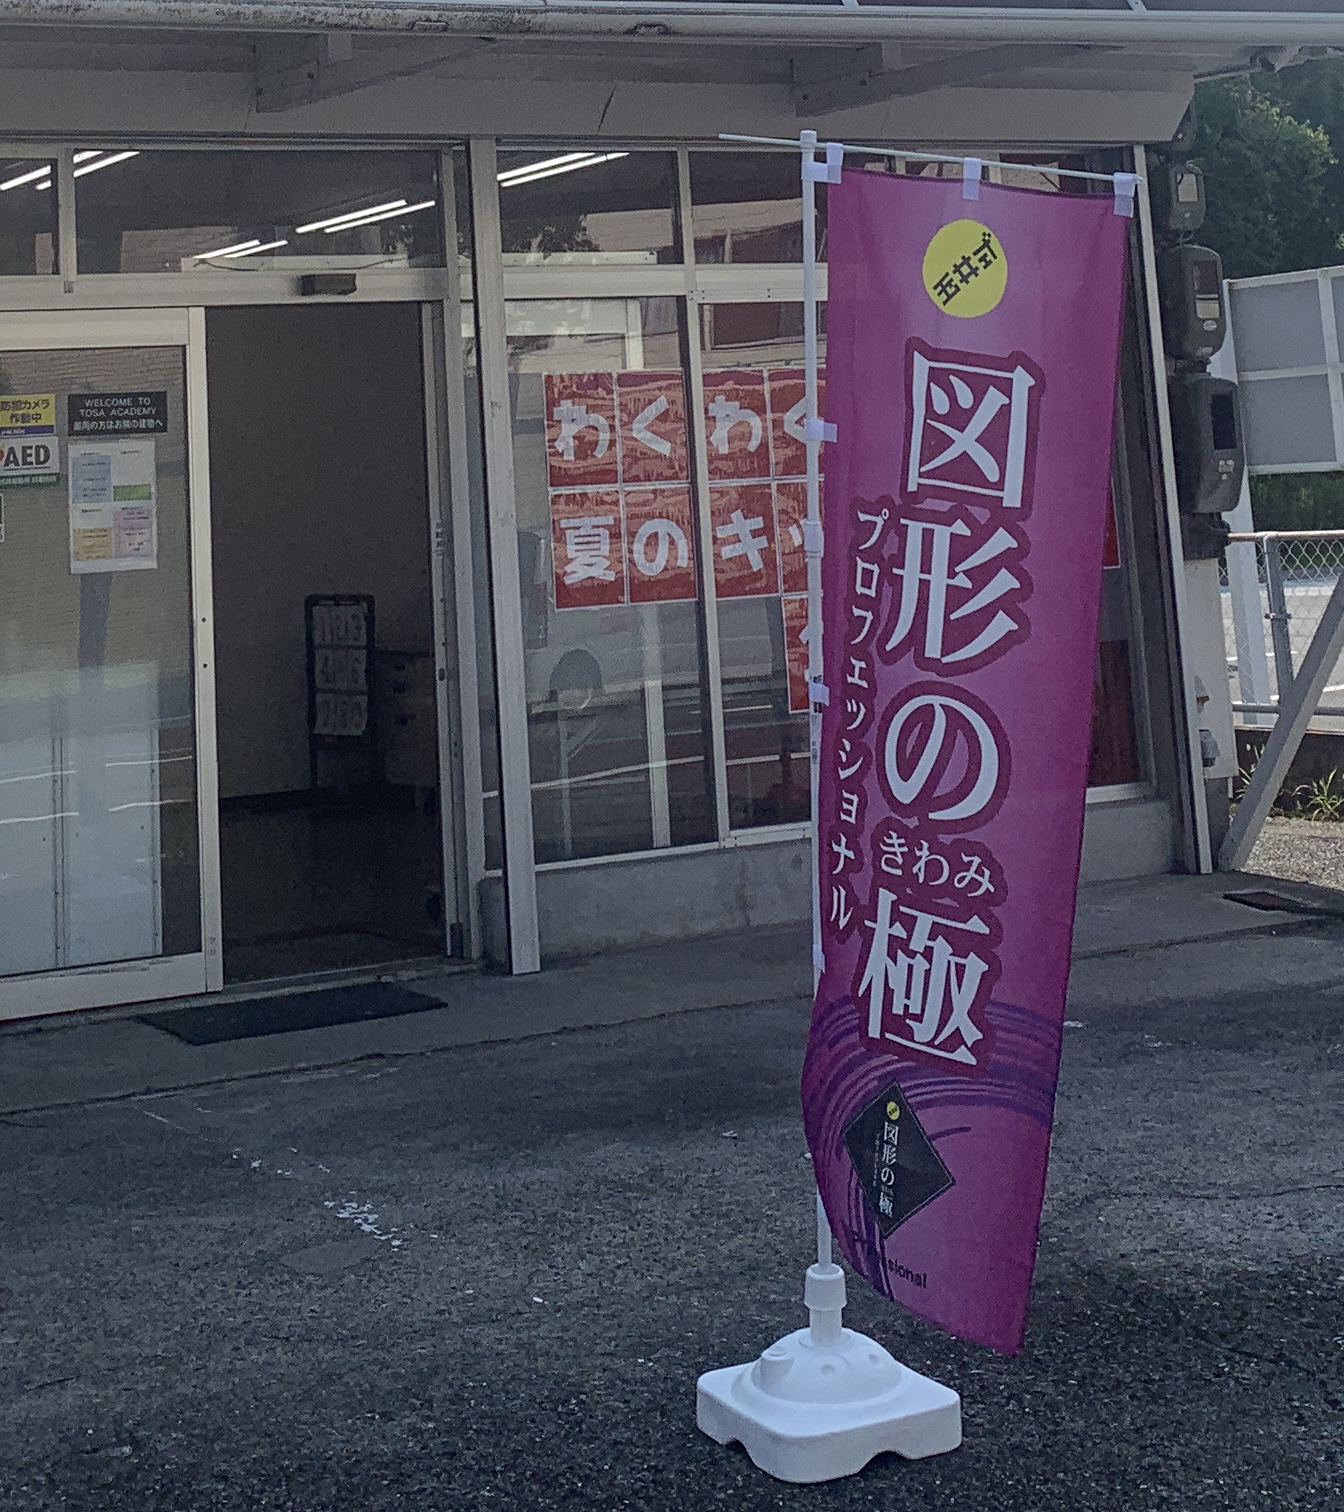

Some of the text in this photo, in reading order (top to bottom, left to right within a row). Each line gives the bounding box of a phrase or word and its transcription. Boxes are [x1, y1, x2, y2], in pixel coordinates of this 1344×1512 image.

[933, 233, 998, 306] 玉井式
[79, 406, 156, 418] TOSA ACADEMY
[84, 396, 151, 408] WELCOME TO
[3, 444, 51, 468] AED
[830, 507, 889, 932] プロフェッショナル
[878, 830, 995, 897] きわみ
